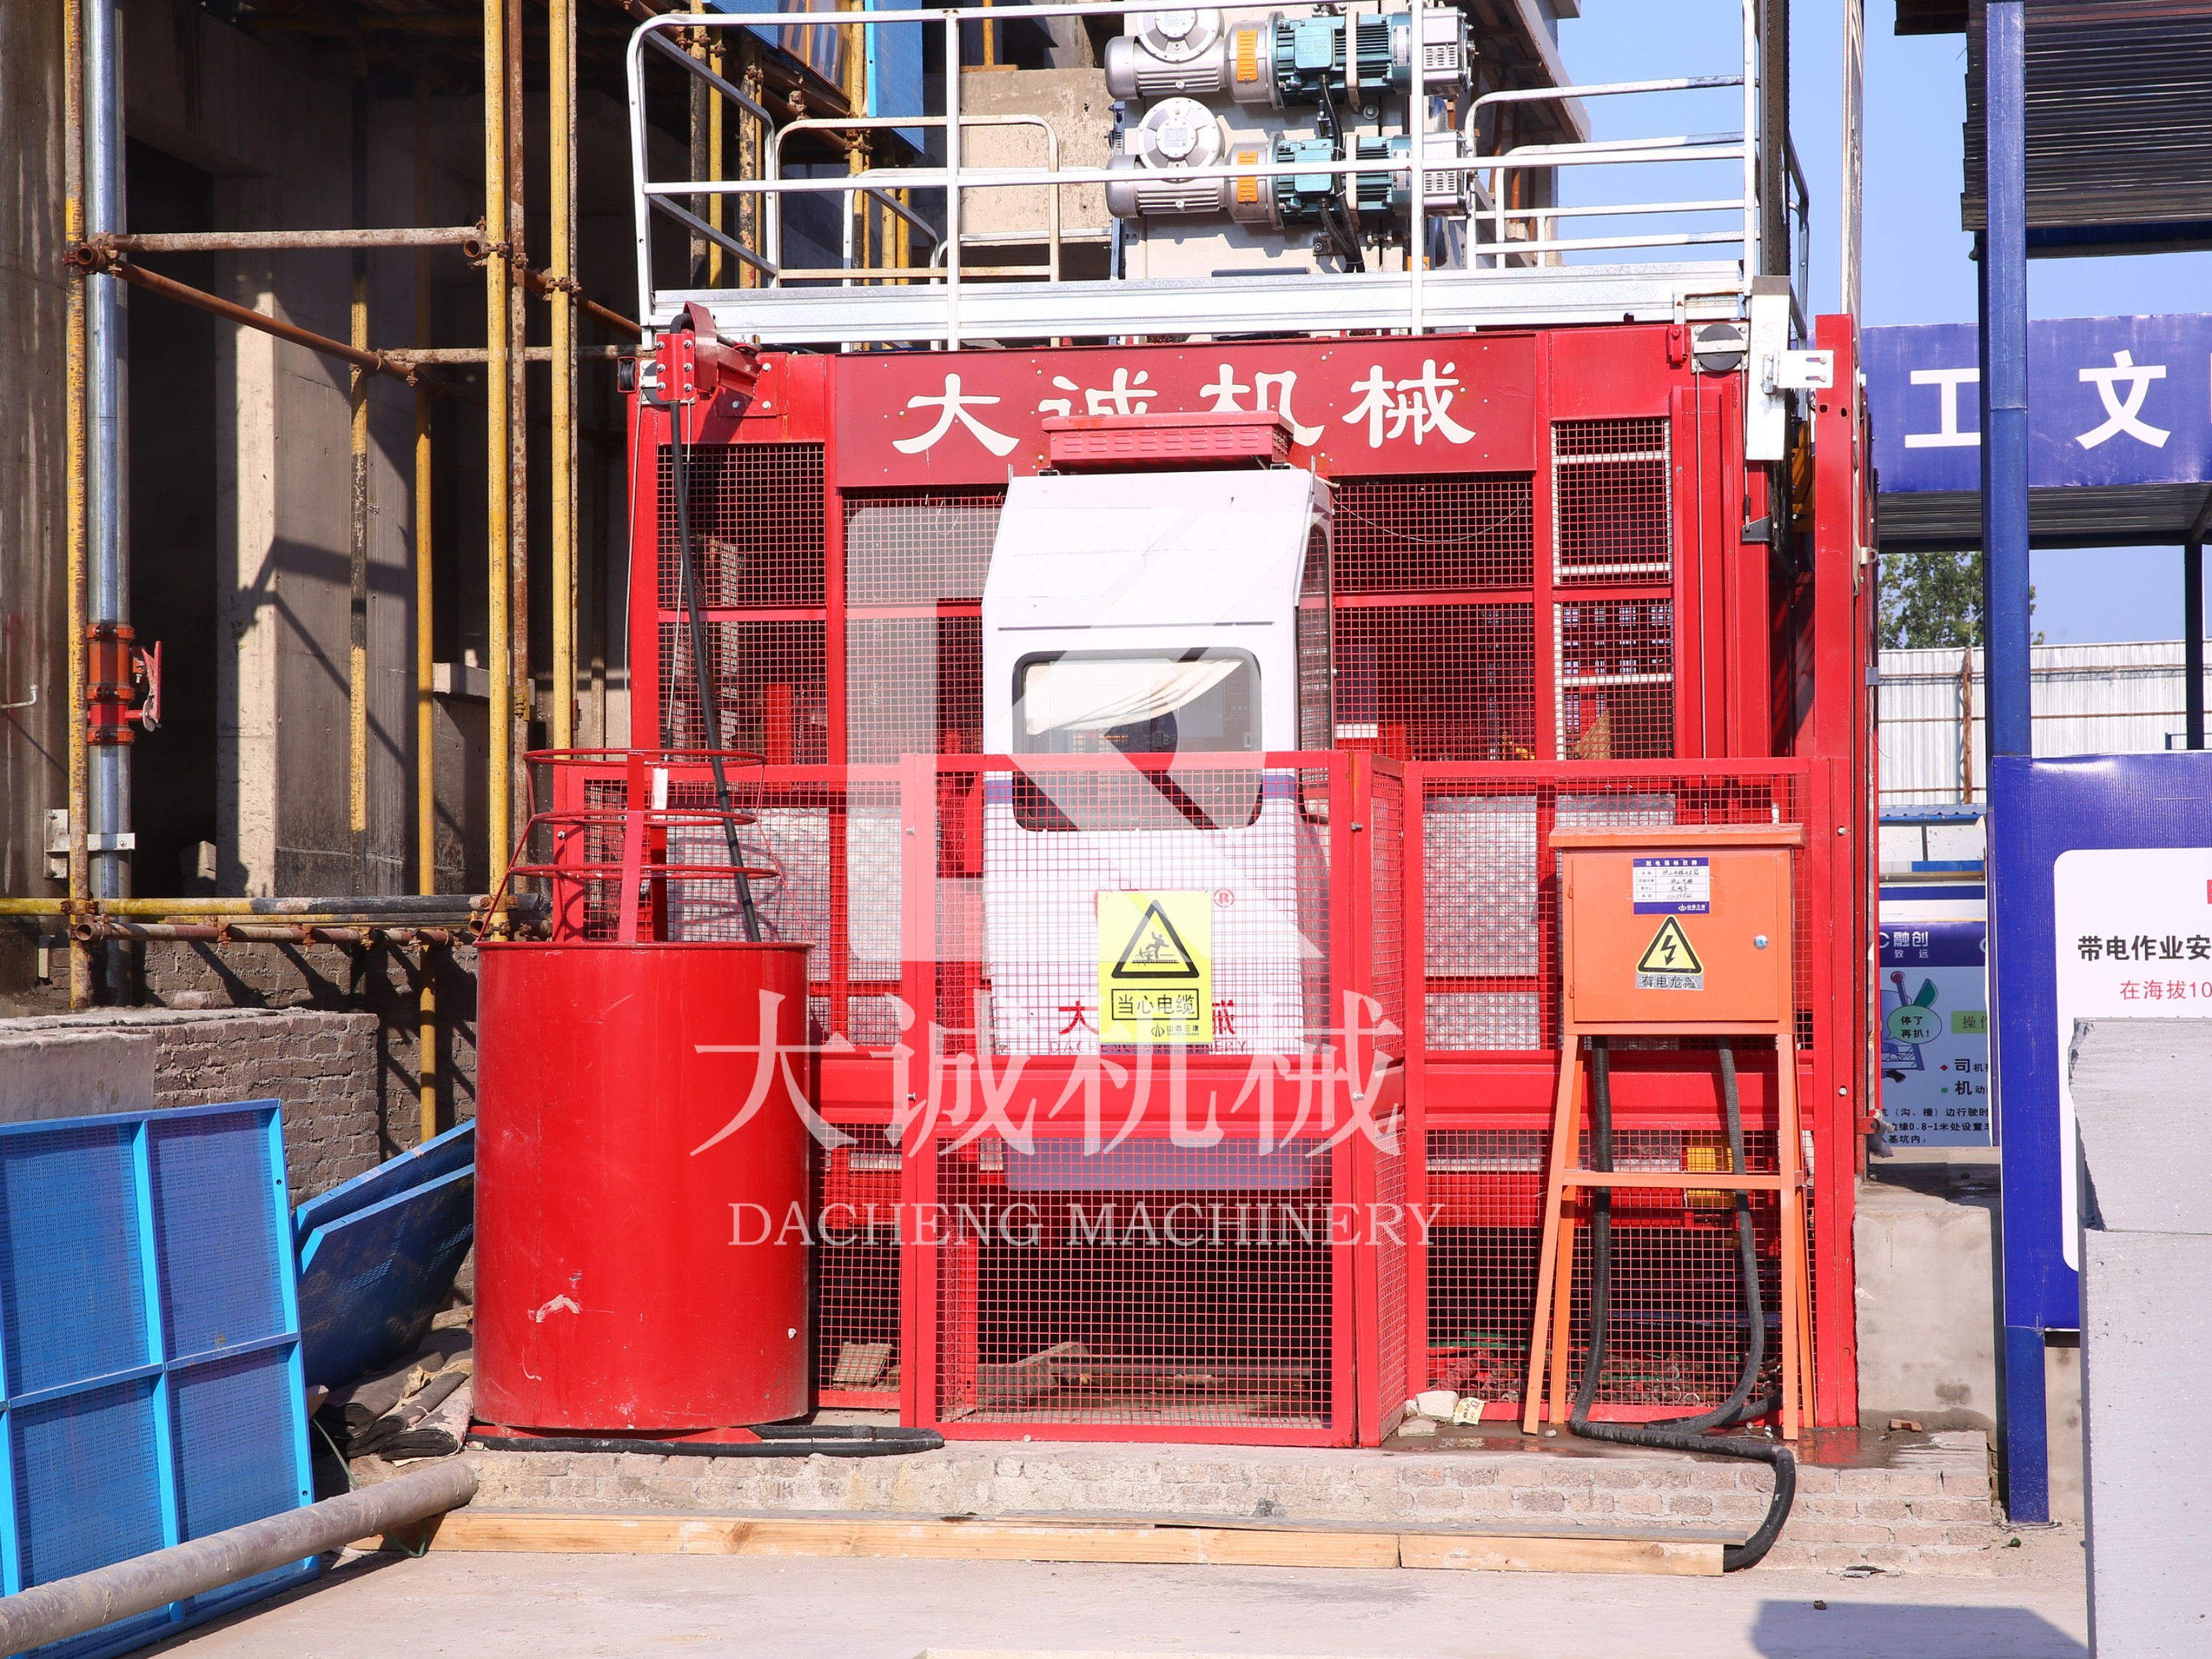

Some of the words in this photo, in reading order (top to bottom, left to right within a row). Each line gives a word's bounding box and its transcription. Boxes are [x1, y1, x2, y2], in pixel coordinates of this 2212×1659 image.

[891, 358, 1476, 458] 大诚机械
[2075, 349, 2171, 451] 文
[1893, 931, 1929, 947] 融创
[2077, 934, 2212, 961] 带电作业安
[1893, 949, 1929, 959] 致远
[1641, 975, 1697, 989] 有电危险
[2120, 979, 2212, 1001] 在海拔10
[1118, 994, 1195, 1015] 当心电缆
[1900, 1016, 1923, 1026] 停了
[1955, 1080, 1989, 1096] 机动
